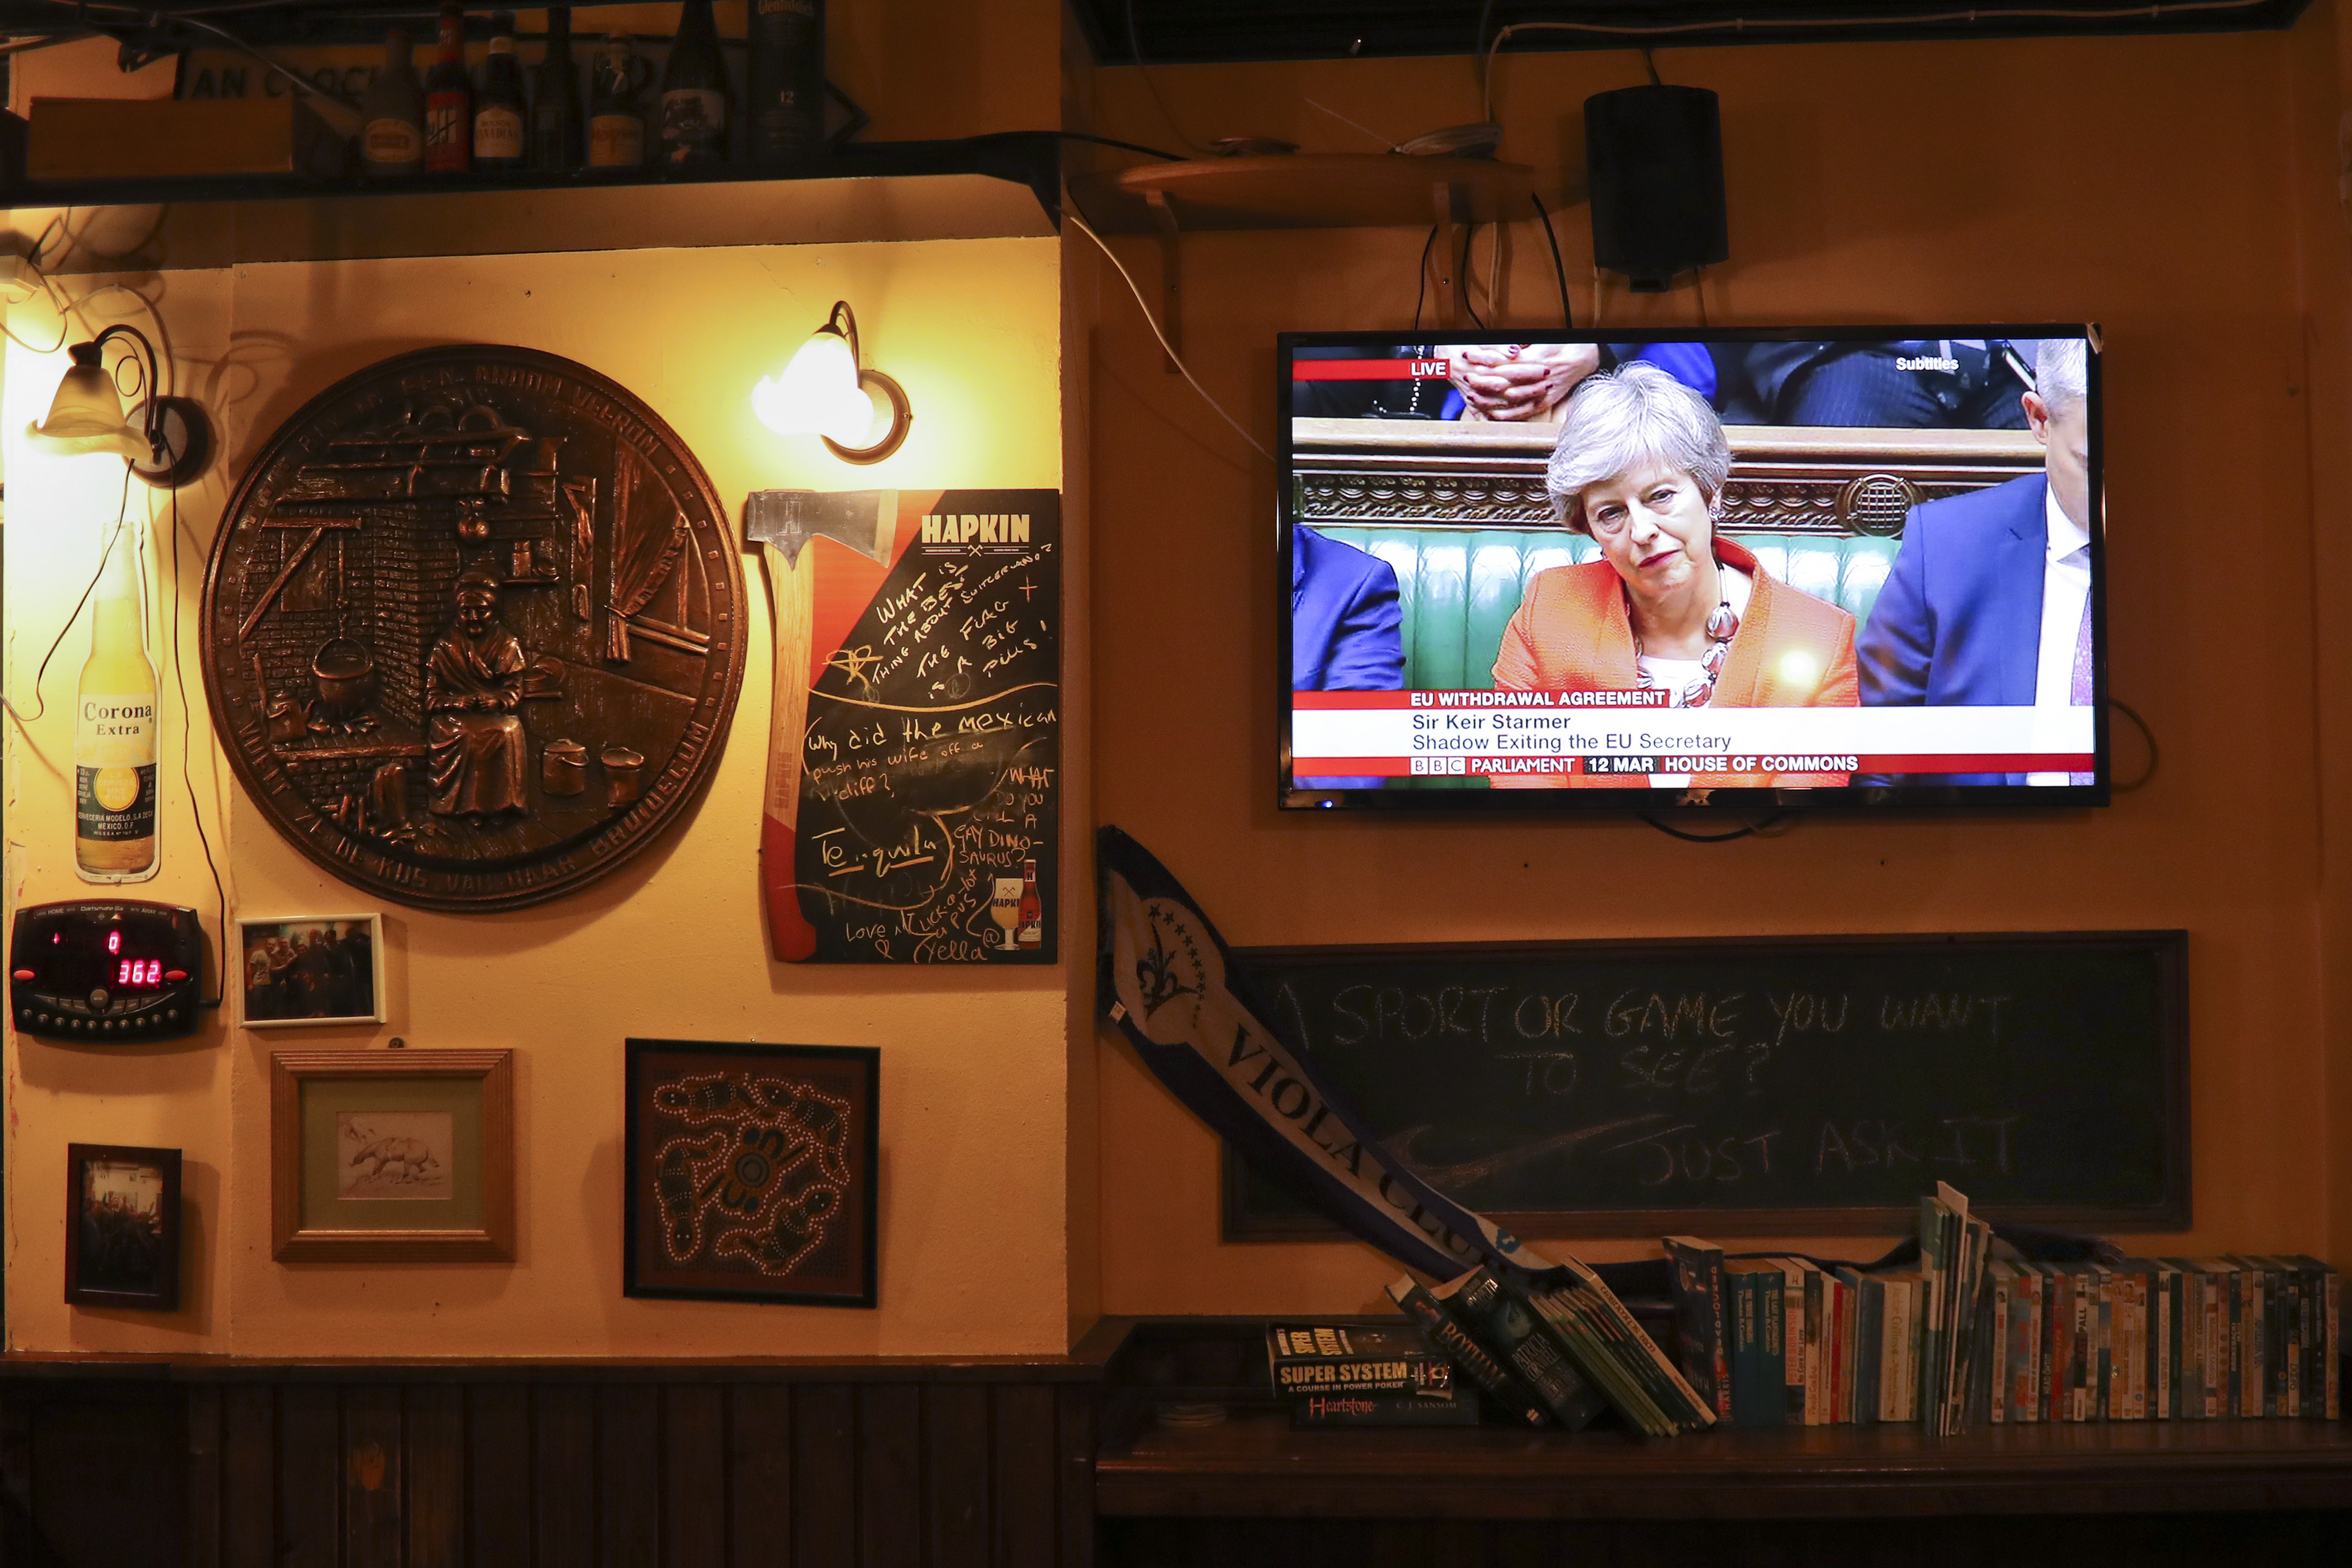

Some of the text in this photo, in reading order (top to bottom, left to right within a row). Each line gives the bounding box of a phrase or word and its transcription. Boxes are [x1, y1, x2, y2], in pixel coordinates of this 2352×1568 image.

[1411, 362, 1446, 375] LIVE
[1896, 357, 1959, 371] Subtitles
[921, 514, 1030, 543] HAPKIN
[877, 572, 926, 624] WHAT
[884, 610, 916, 645] THE
[872, 647, 909, 685] THING
[914, 597, 953, 643] ABOUT
[917, 645, 950, 678] THE
[957, 656, 972, 674] A
[1411, 691, 1666, 706] EU WITHDRAWAL AGREEMENT
[84, 701, 152, 722] Corona
[1413, 713, 1571, 729] Sir Keir Starmer
[96, 723, 140, 735] Extra
[809, 735, 837, 762] Why
[849, 722, 887, 750] did
[903, 717, 942, 743] the
[1413, 733, 1731, 753] Shadow Exiting the EU Secretary
[813, 763, 851, 785] push
[857, 758, 877, 771] his
[888, 747, 928, 765] wife
[941, 746, 961, 757] off
[1412, 756, 1859, 774] BBC PARLIAMENT 12 MAR HOUSE OF COMMONS
[1009, 766, 1055, 790] WHAT
[1019, 793, 1043, 813] YOU
[1025, 814, 1037, 829] A
[954, 824, 984, 852] GAY
[959, 848, 1026, 868] SAURUS?
[993, 898, 1019, 907] HAPKI
[846, 922, 886, 942] Love
[118, 962, 159, 985] 362
[1332, 984, 1509, 1045] SPORT
[1515, 993, 1582, 1040] OR
[1604, 988, 1746, 1041] GAME
[1767, 992, 1849, 1046] YOU
[1881, 993, 2012, 1044] WANT
[1495, 1051, 1577, 1096] TO
[1228, 1023, 1363, 1180] VIOLA
[1606, 1115, 2021, 1185] JUST ASK IT
[1890, 1316, 1903, 1347] Collins
[1436, 1321, 1508, 1390] BOTHAM
[1512, 1332, 1551, 1367] PATRICIA
[1281, 1361, 1408, 1385] SUPER SYSTEM
[1296, 1384, 1330, 1392] COURSE
[1375, 1381, 1405, 1389] POKER
[1721, 1373, 1732, 1411] HARRIS
[1309, 1397, 1379, 1419] Heartstone
